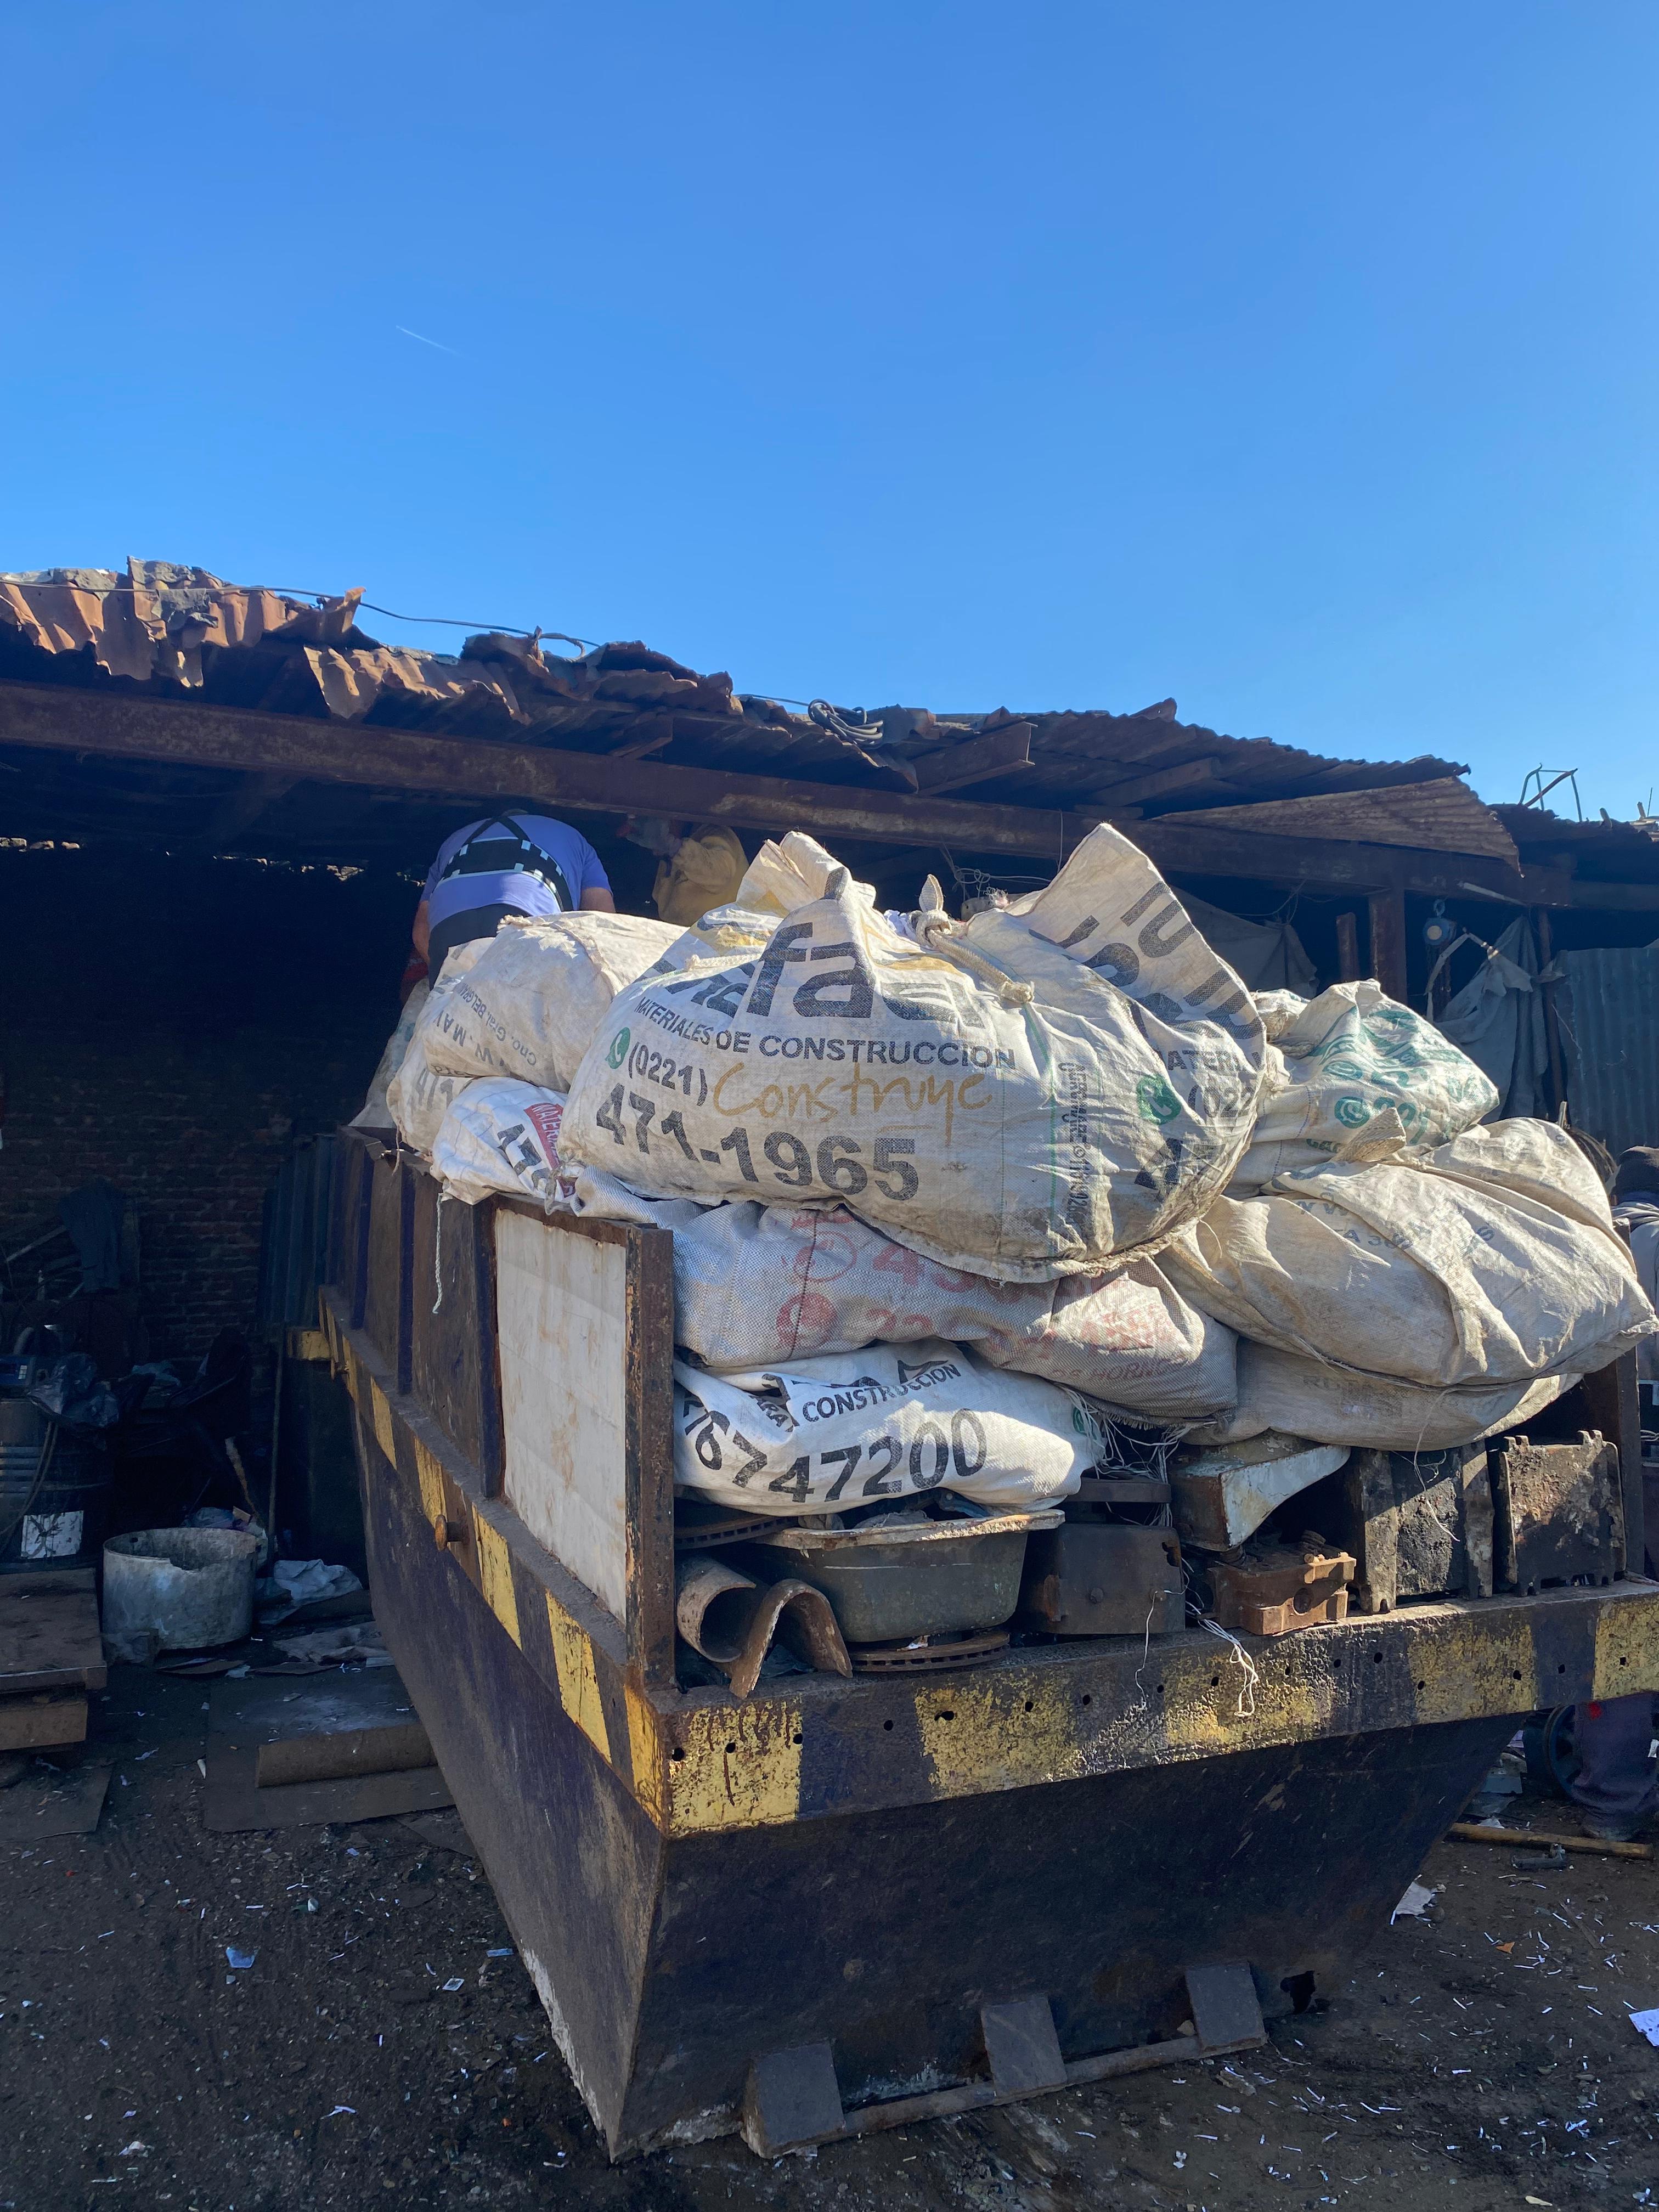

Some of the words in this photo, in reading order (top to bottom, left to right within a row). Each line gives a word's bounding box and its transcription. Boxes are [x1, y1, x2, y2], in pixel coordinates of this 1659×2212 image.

[634, 996, 714, 1045] MATERIALES
[759, 1035, 1015, 1070] CONSTRUCCION
[628, 1042, 708, 1107] (0221)
[596, 1083, 919, 1201] 471-1965
